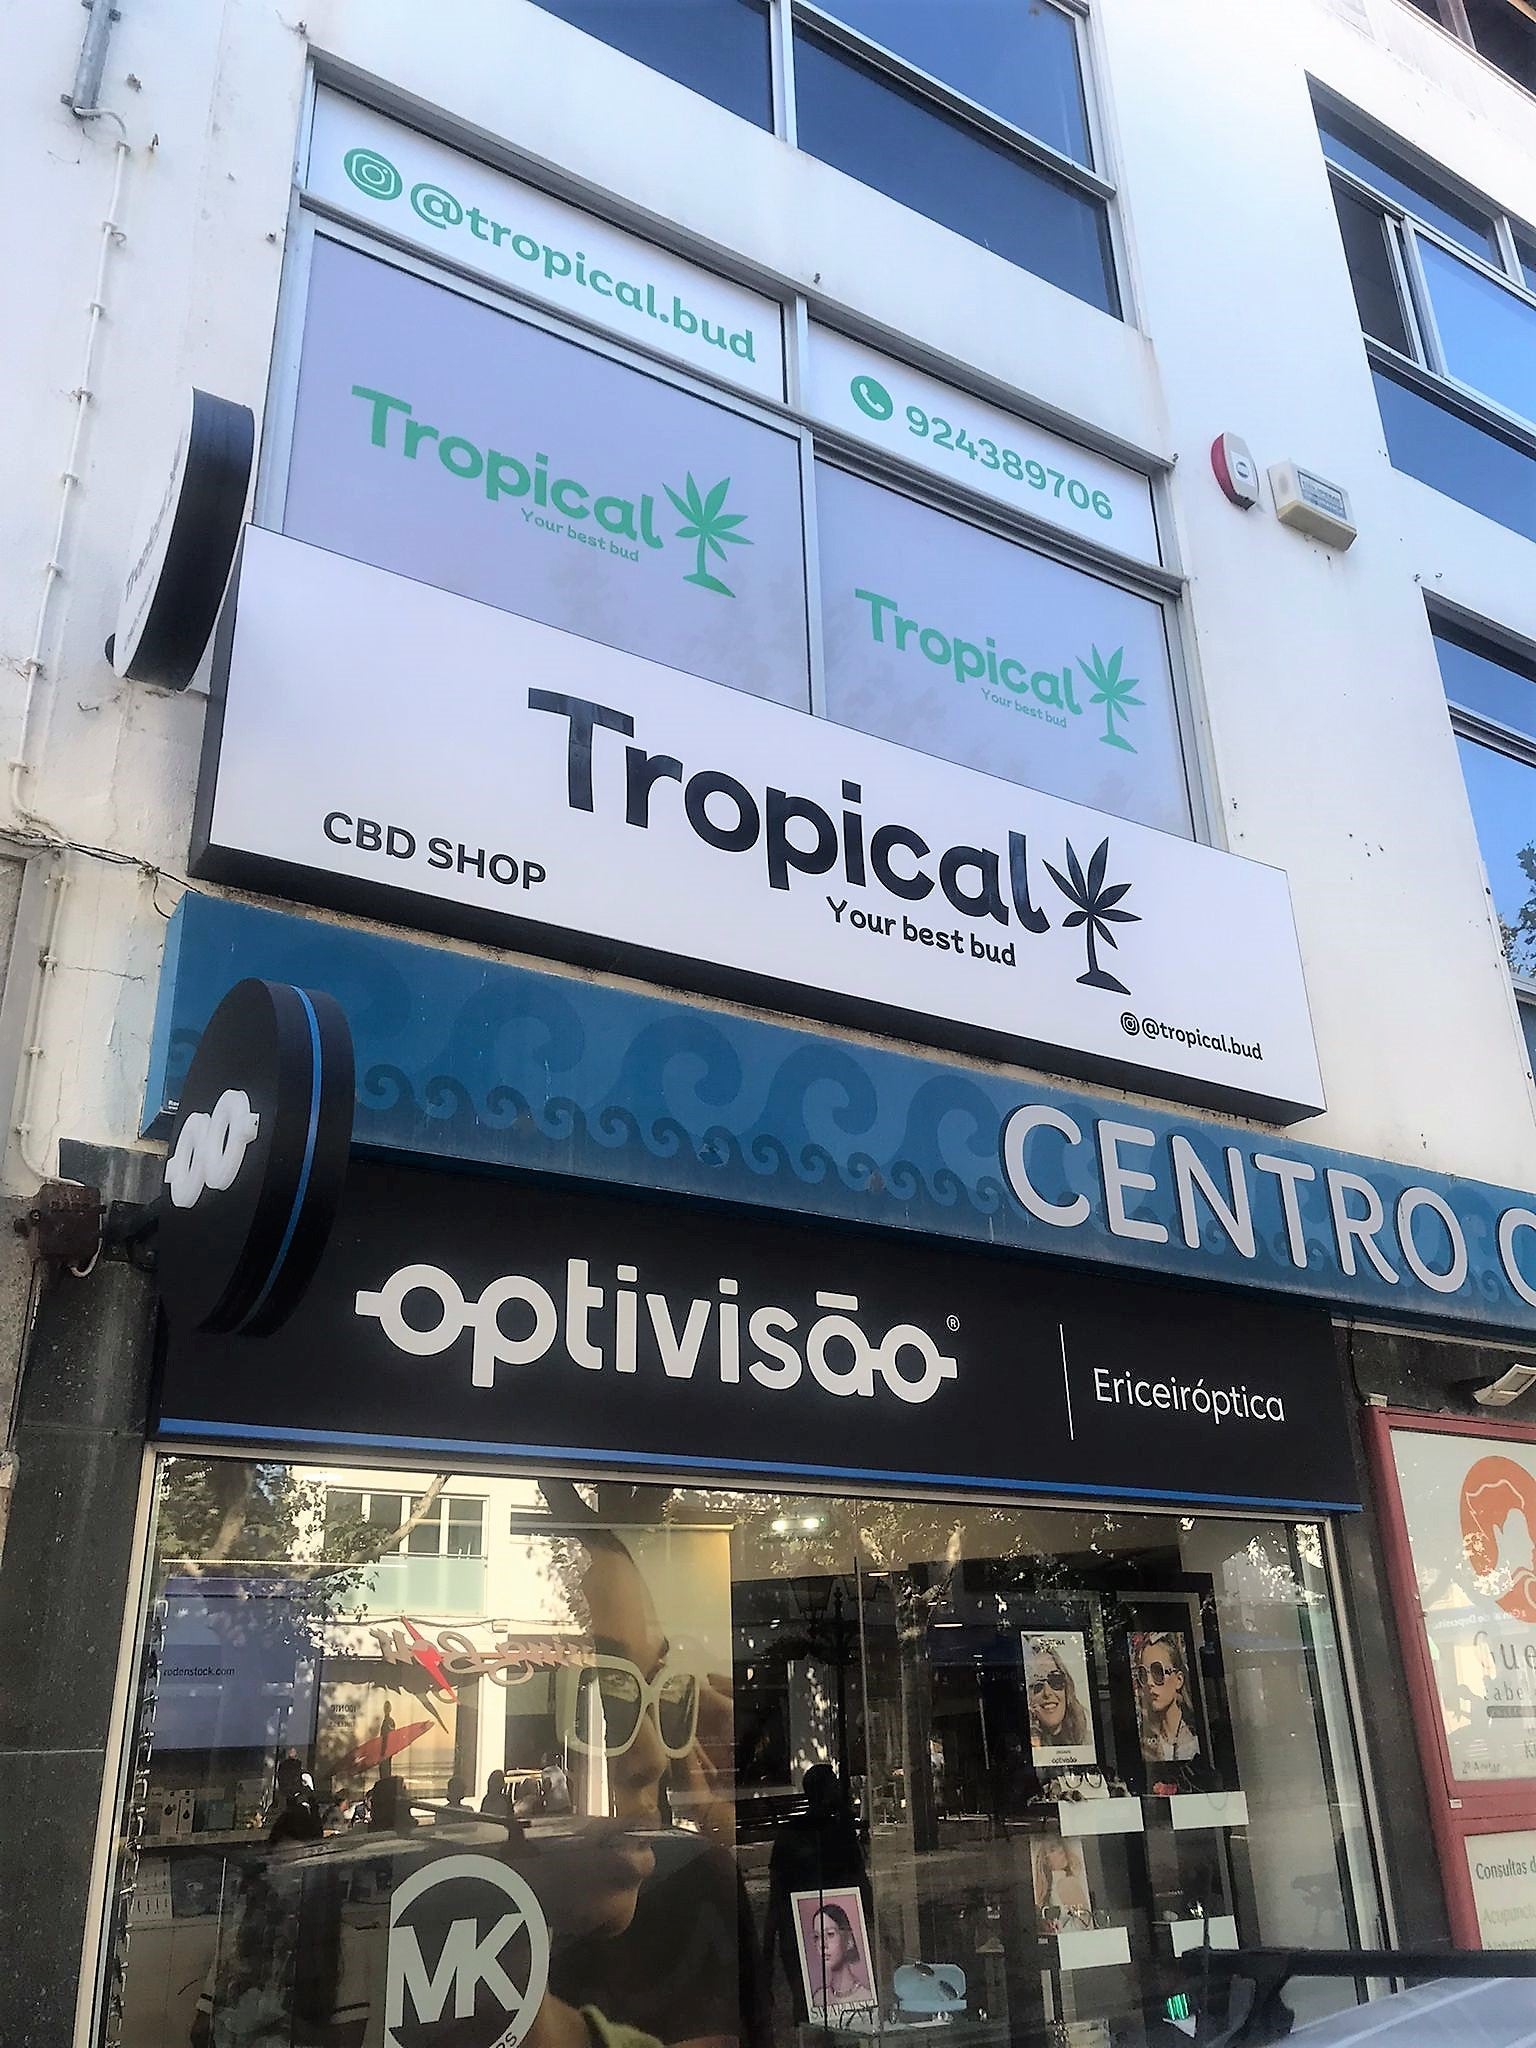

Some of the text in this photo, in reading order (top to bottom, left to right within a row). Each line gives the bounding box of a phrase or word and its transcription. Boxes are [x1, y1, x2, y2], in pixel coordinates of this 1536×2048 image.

[410, 182, 756, 363] @tropical.bud
[352, 385, 663, 549] Tropical
[905, 405, 1113, 520] 924389706
[521, 507, 639, 562] Your best bud
[855, 589, 1083, 715] Tropical
[981, 687, 1067, 728] Your best bud
[322, 811, 547, 890] CBD SHOP
[528, 687, 1051, 934] Tropical
[825, 895, 1017, 967] Your best bud
[1141, 1017, 1263, 1061] @tropical.bud
[1003, 1103, 1468, 1294] CENTRO
[354, 1258, 959, 1405] optivisão
[1092, 1367, 1286, 1424] Ericeiróptica
[1476, 1858, 1528, 1880] Consultas
[384, 1914, 526, 2028] MK
